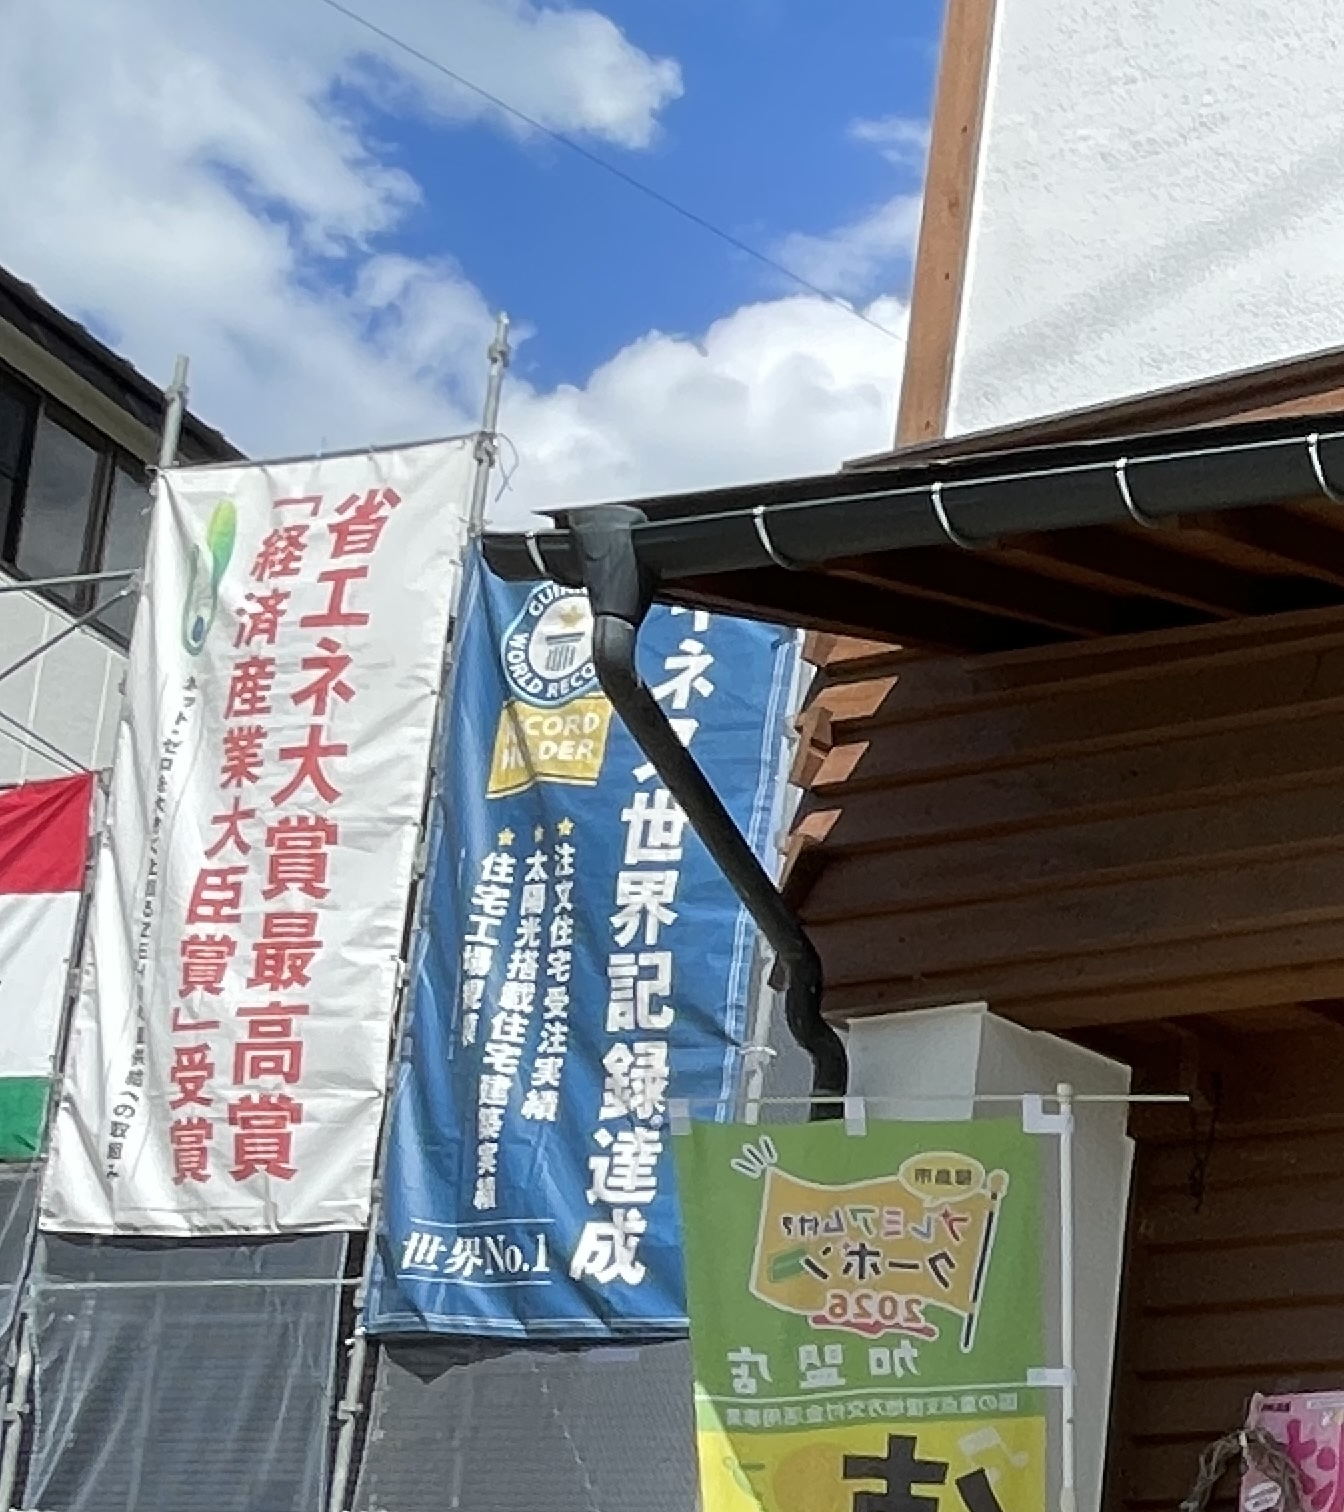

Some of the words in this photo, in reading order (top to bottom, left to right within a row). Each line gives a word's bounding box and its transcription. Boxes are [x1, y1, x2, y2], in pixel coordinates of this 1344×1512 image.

[169, 492, 308, 1185] 「経済産業大臣賞」受賞
[226, 489, 400, 1182] 省エネ大賞最高賞
[506, 632, 543, 693] WORLD
[546, 662, 597, 698] RECO
[400, 1231, 551, 1277] 世界No.1
